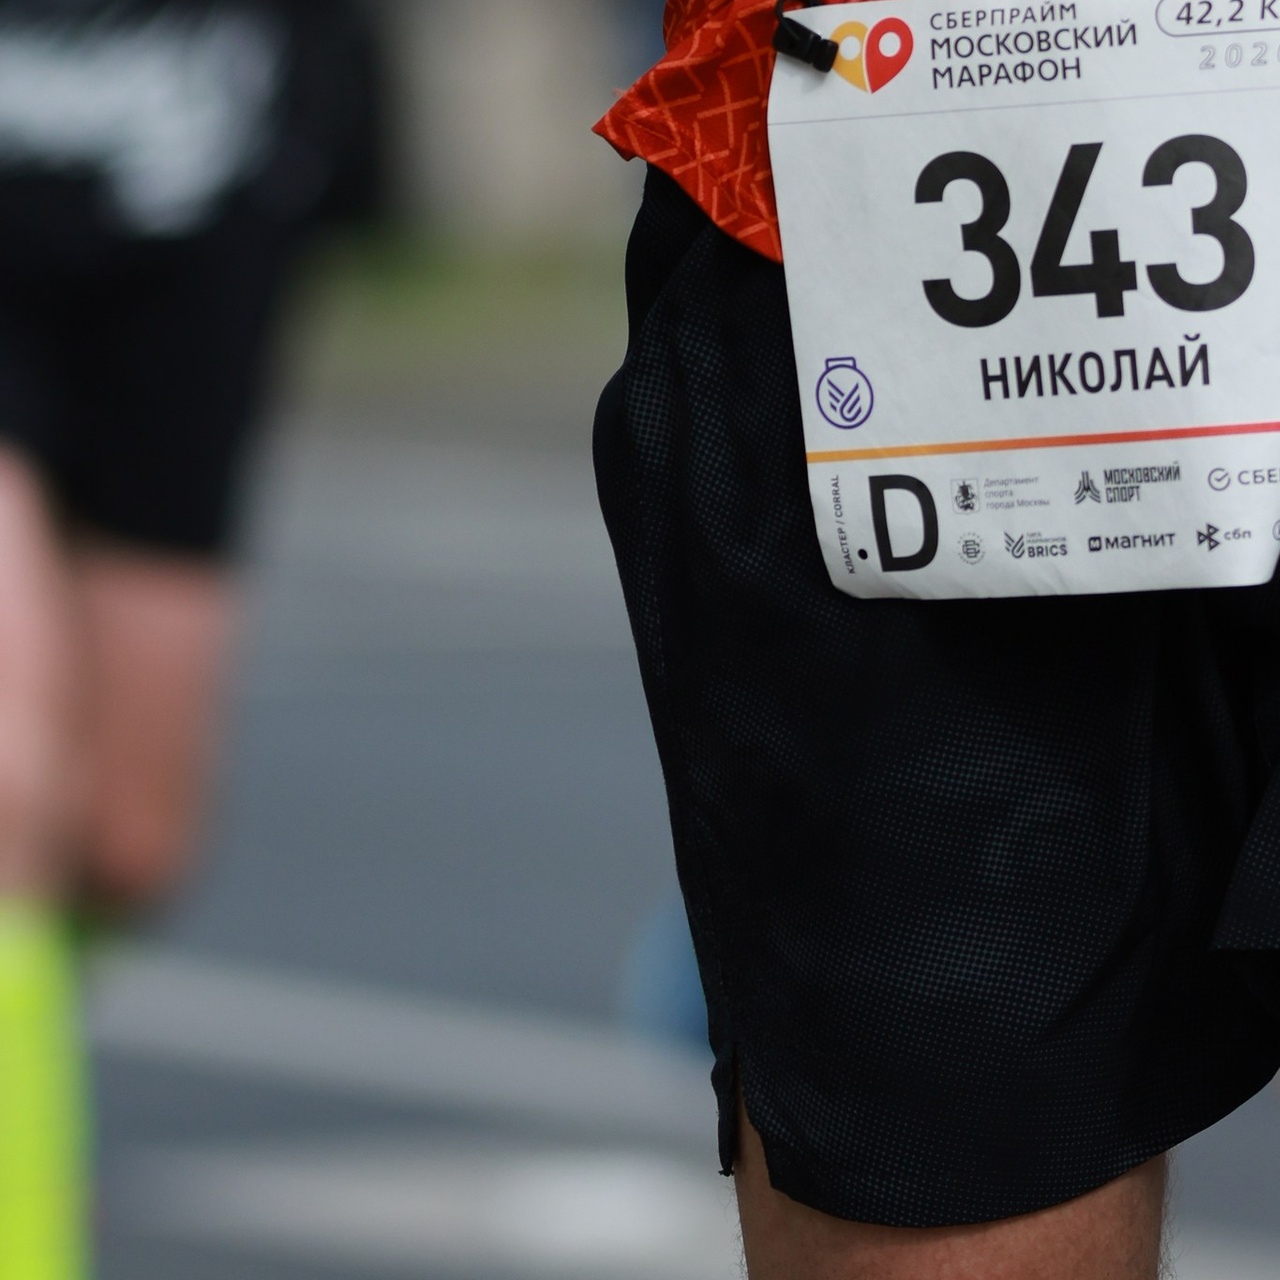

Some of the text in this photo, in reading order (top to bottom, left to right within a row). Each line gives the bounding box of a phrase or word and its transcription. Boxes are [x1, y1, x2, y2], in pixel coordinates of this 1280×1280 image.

[929, 1, 1077, 30] СБЕРПРАЙМ
[931, 18, 1138, 60] МОСКОВСКИЙ
[932, 57, 1082, 90] МАРАФОН
[914, 134, 1255, 328] 343
[980, 333, 1211, 401] НИКОЛАЙ
[1103, 460, 1181, 485] МОСКОВСКИЙ
[831, 475, 843, 518] CORRAL
[1105, 485, 1140, 503] СПОРТ
[868, 474, 939, 572] D
[837, 527, 856, 575] КЛАСТЕР
[1027, 544, 1068, 558] BRICS
